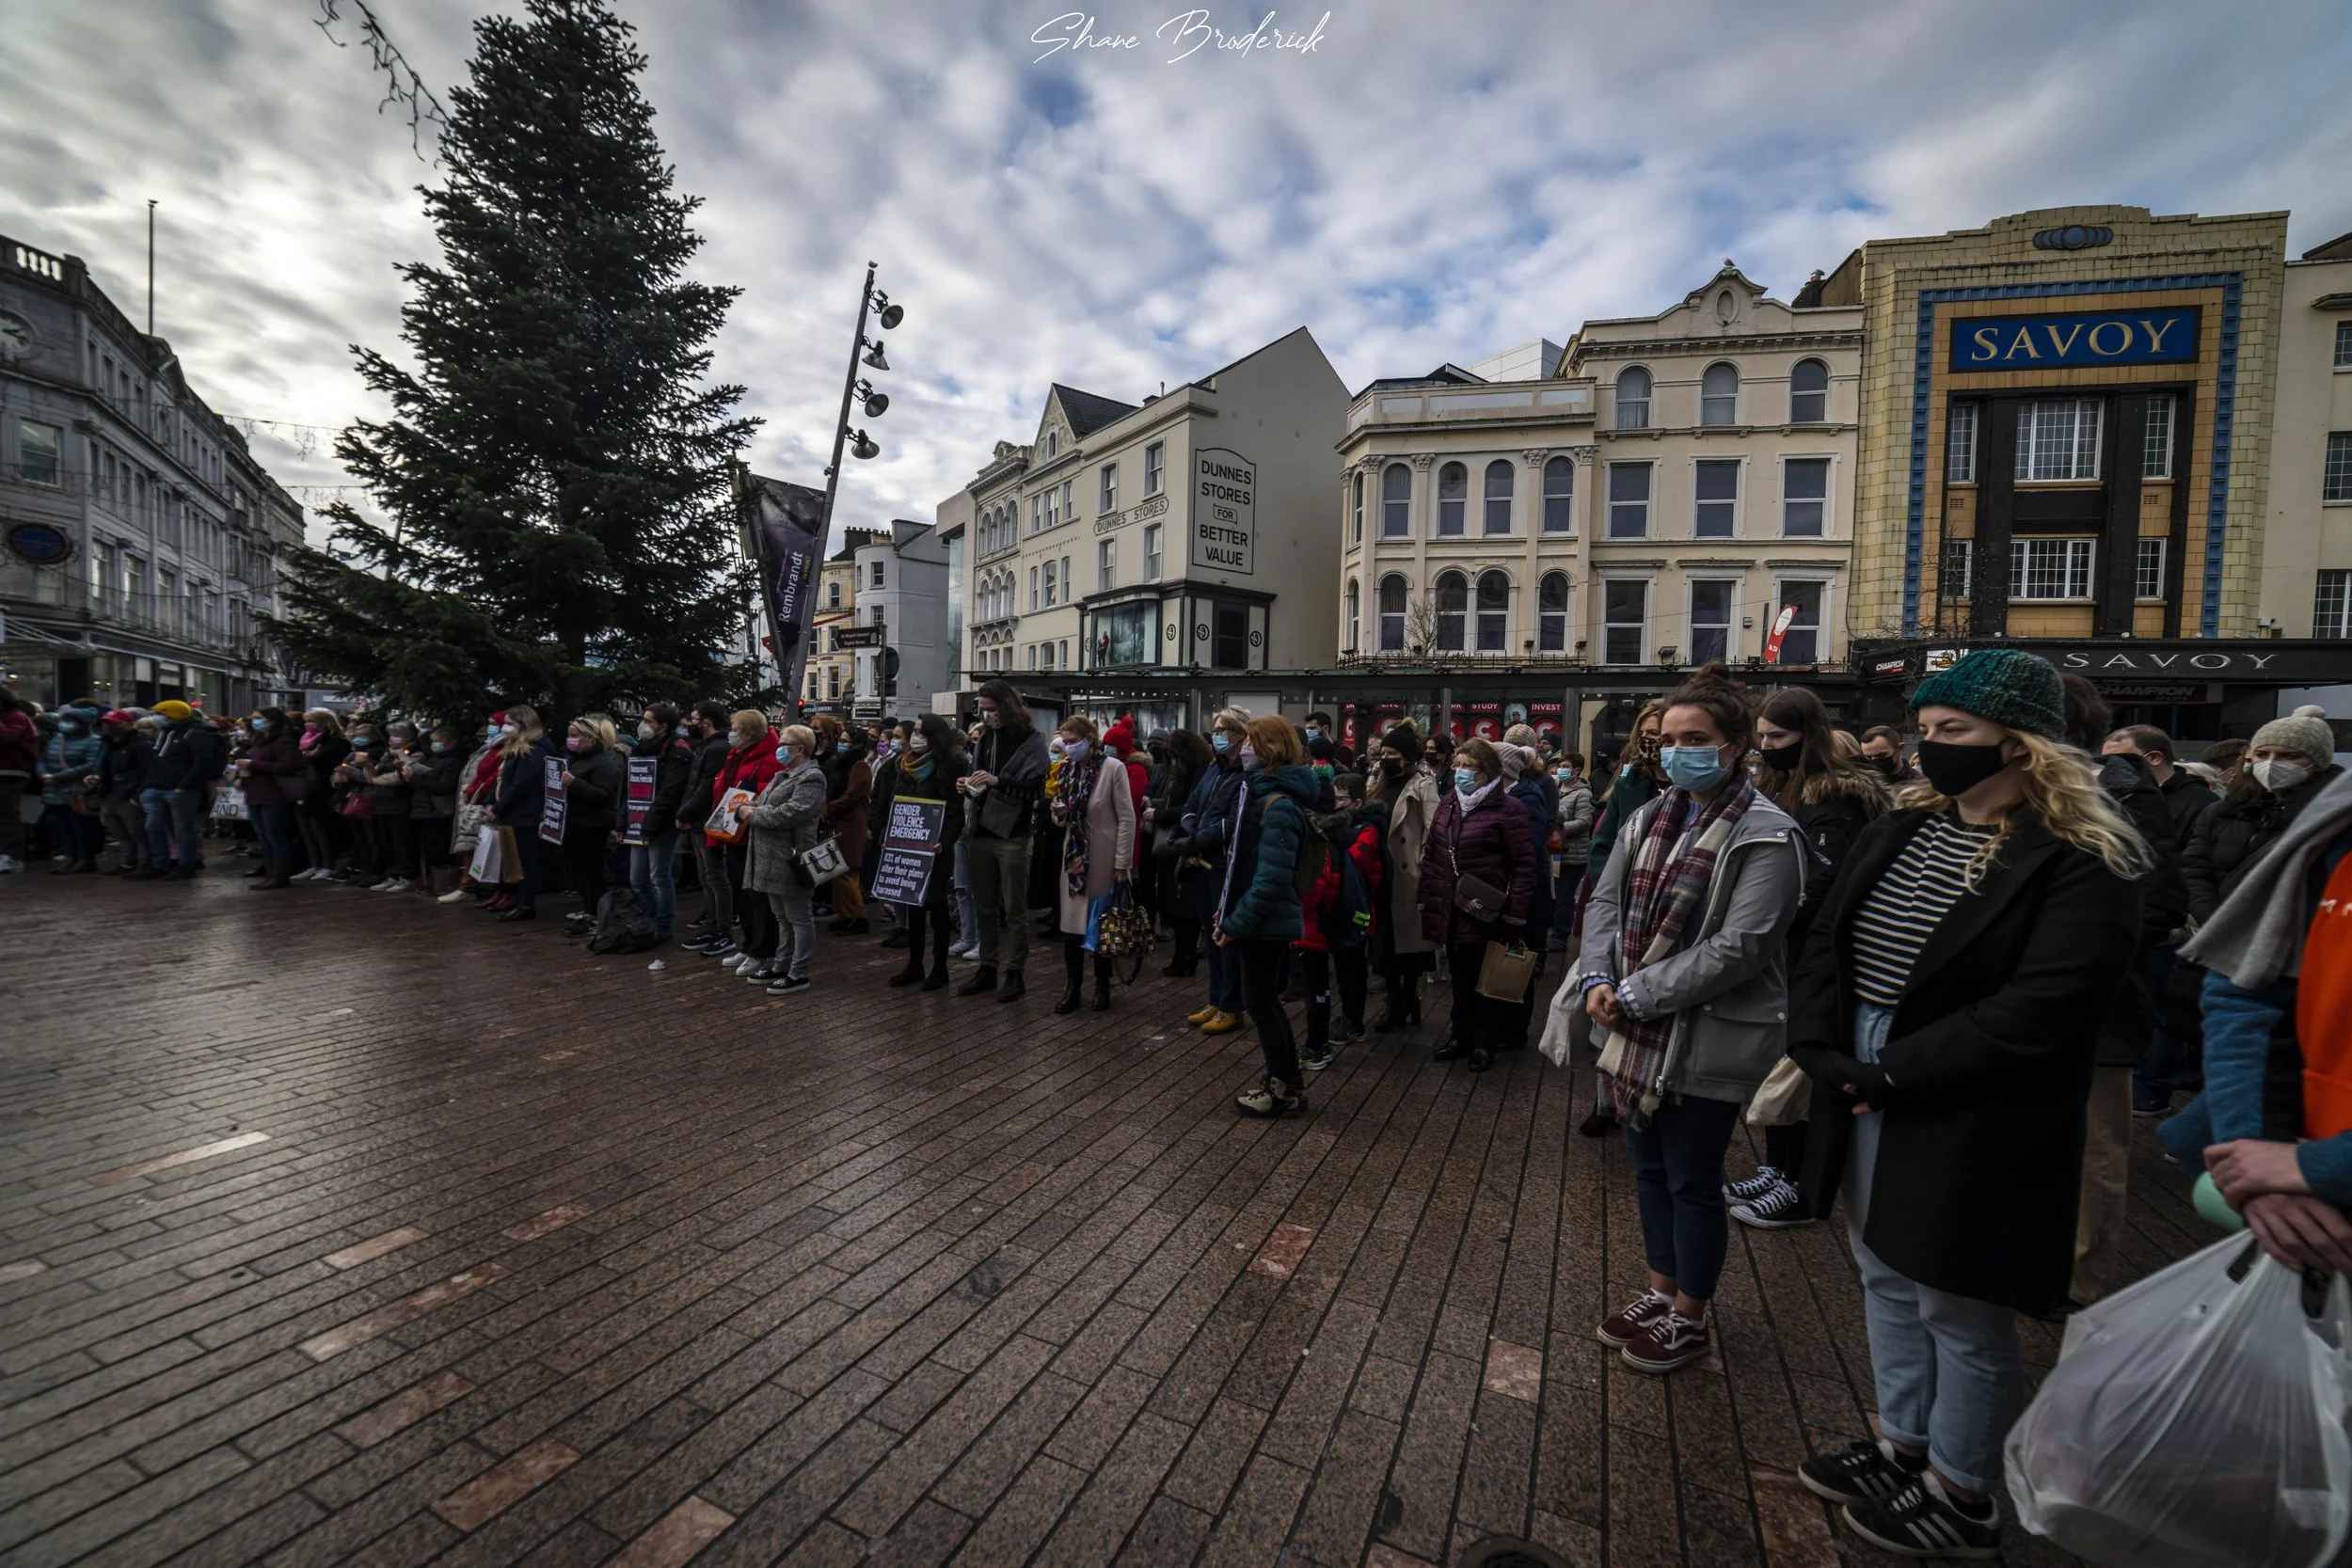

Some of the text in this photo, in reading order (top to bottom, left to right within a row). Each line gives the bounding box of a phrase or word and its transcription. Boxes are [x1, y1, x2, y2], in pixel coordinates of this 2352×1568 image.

[1970, 316, 2181, 363] SAVOY
[1201, 459, 1252, 484] DUNNES
[1201, 482, 1250, 505] STORES
[1097, 499, 1166, 533] DUNNES STORES
[1216, 508, 1233, 520] FOR
[1200, 524, 1248, 547] BETTER
[1205, 546, 1244, 567] VALUE
[778, 551, 803, 623] Rembrandt
[1875, 659, 1905, 671] CHAMPION
[2062, 653, 2281, 670] SAVOY
[1532, 703, 1562, 711] INVEST
[894, 803, 921, 816] GENDER
[892, 815, 926, 828] VIOLENCE
[889, 826, 930, 841] EMERGENCY
[895, 853, 901, 863] of
[901, 857, 922, 866] women
[895, 864, 908, 875] their
[908, 868, 924, 879] plans
[876, 885, 901, 896] harassed
[878, 875, 917, 891] to avoid being
